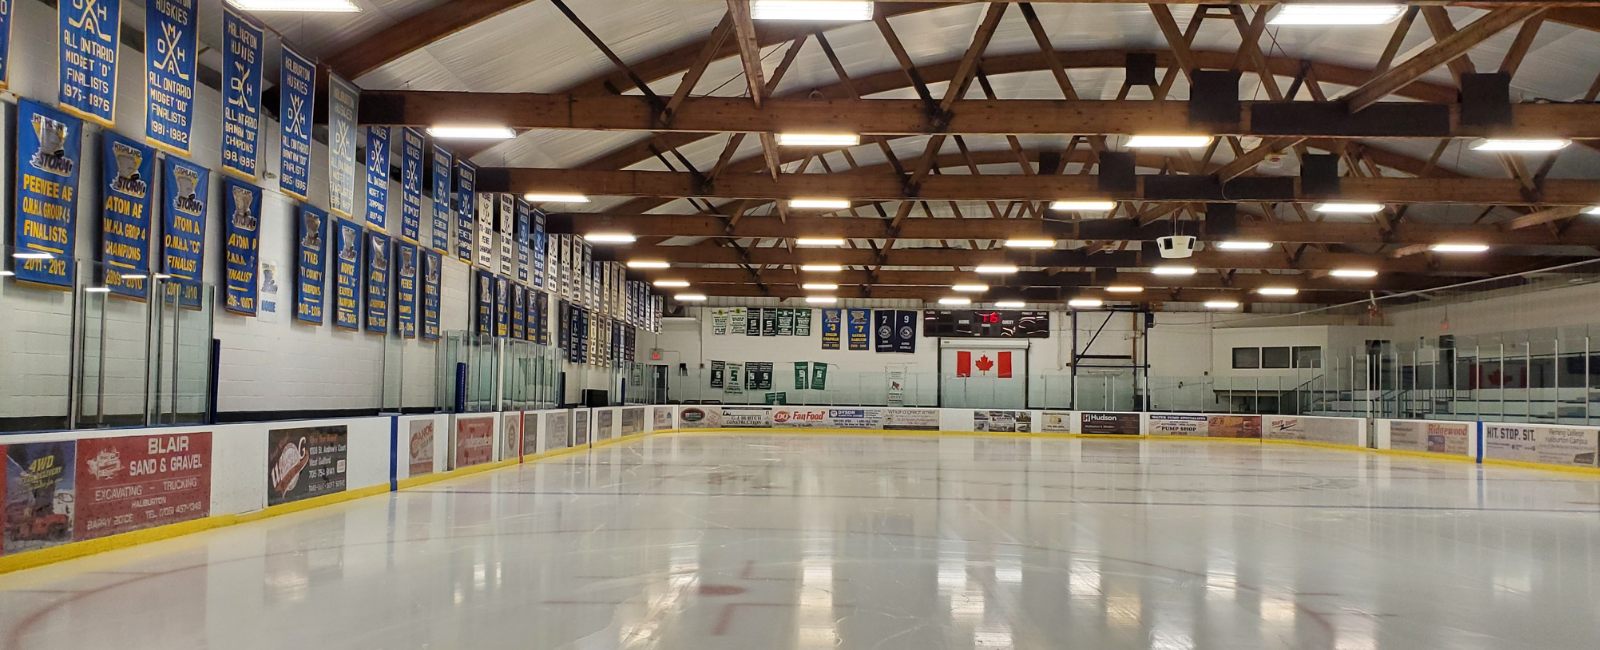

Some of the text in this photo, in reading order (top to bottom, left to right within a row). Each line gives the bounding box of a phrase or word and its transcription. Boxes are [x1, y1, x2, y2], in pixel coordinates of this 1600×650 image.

[64, 30, 114, 63] ALL ONTARIO
[67, 68, 109, 94] FINALISTS
[149, 70, 192, 99] ALL ONTARIO
[89, 93, 110, 112] 1976
[150, 88, 174, 105] MIDGET
[151, 104, 187, 126] FINALISTS
[225, 106, 237, 121] ALL
[151, 121, 188, 143] 1981 1982
[39, 152, 70, 174] STORM
[117, 177, 145, 197] STORM
[106, 195, 130, 216] ATOM
[23, 219, 67, 245] FINALISTS
[194, 221, 200, 235] A
[106, 240, 141, 261] CHAMPIONS
[228, 233, 250, 250] ATOM
[23, 258, 66, 277] 2011 2012
[882, 315, 888, 324] 7
[904, 315, 910, 324] 9
[792, 411, 806, 421] Fan
[806, 410, 825, 420] Food
[1090, 414, 1117, 422] Hudson
[1428, 423, 1468, 436] Ridgewood
[1487, 427, 1536, 442] HIT. STOP. SIT.
[1549, 428, 1585, 438] Fleming College
[148, 436, 189, 455] BLAIR
[1570, 437, 1588, 445] Campus
[29, 455, 54, 472] 4WD
[129, 454, 202, 477] SAND & GRAVEL
[95, 478, 197, 502] EXCAVATING TRUCKING
[131, 497, 167, 509] HALIBURTON
